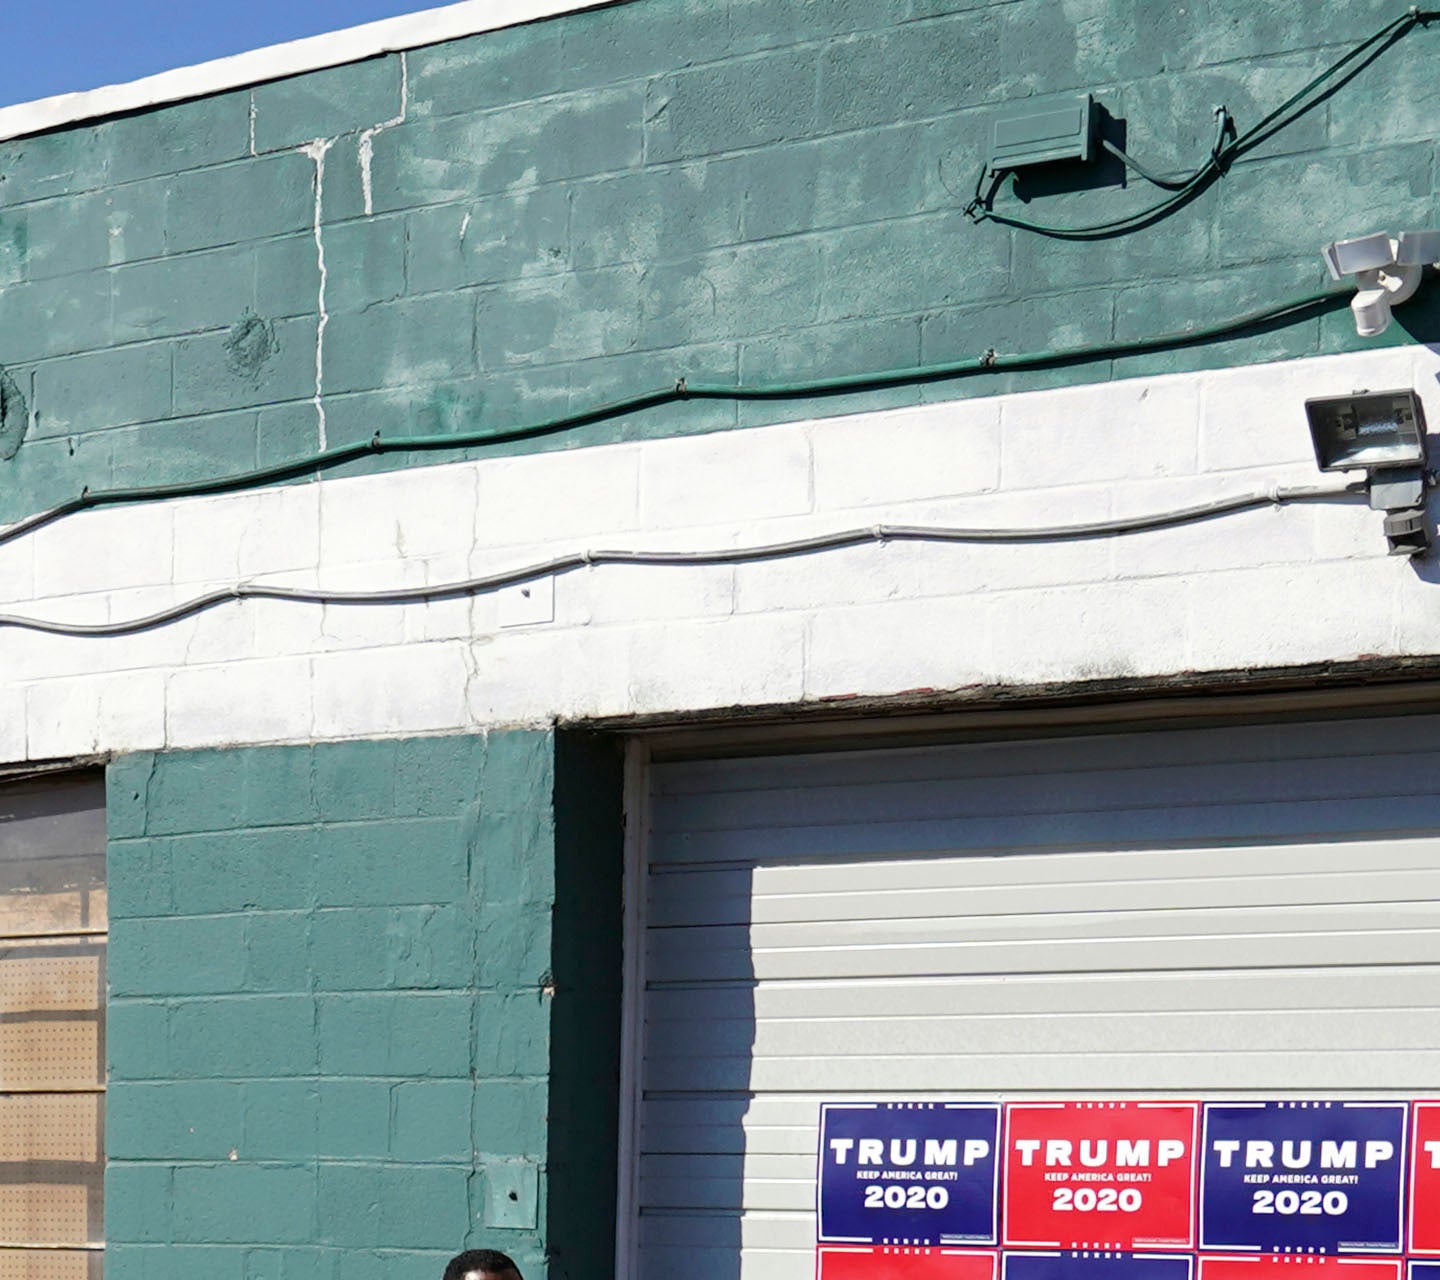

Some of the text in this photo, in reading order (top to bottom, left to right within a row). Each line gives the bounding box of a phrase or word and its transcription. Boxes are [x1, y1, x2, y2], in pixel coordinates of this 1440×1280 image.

[830, 1139, 989, 1165] TRUMP
[1016, 1140, 1184, 1166] TRUMP
[1214, 1140, 1393, 1168] TRUMP
[857, 1171, 957, 1180] KEEP AMERICA GREAT!
[1072, 1173, 1113, 1181] AMERICA
[1244, 1174, 1358, 1184] KEEP AMERICA GREAT!
[865, 1186, 948, 1209] 2020
[1053, 1188, 1141, 1211] 2020
[1253, 1190, 1347, 1215] 2020
